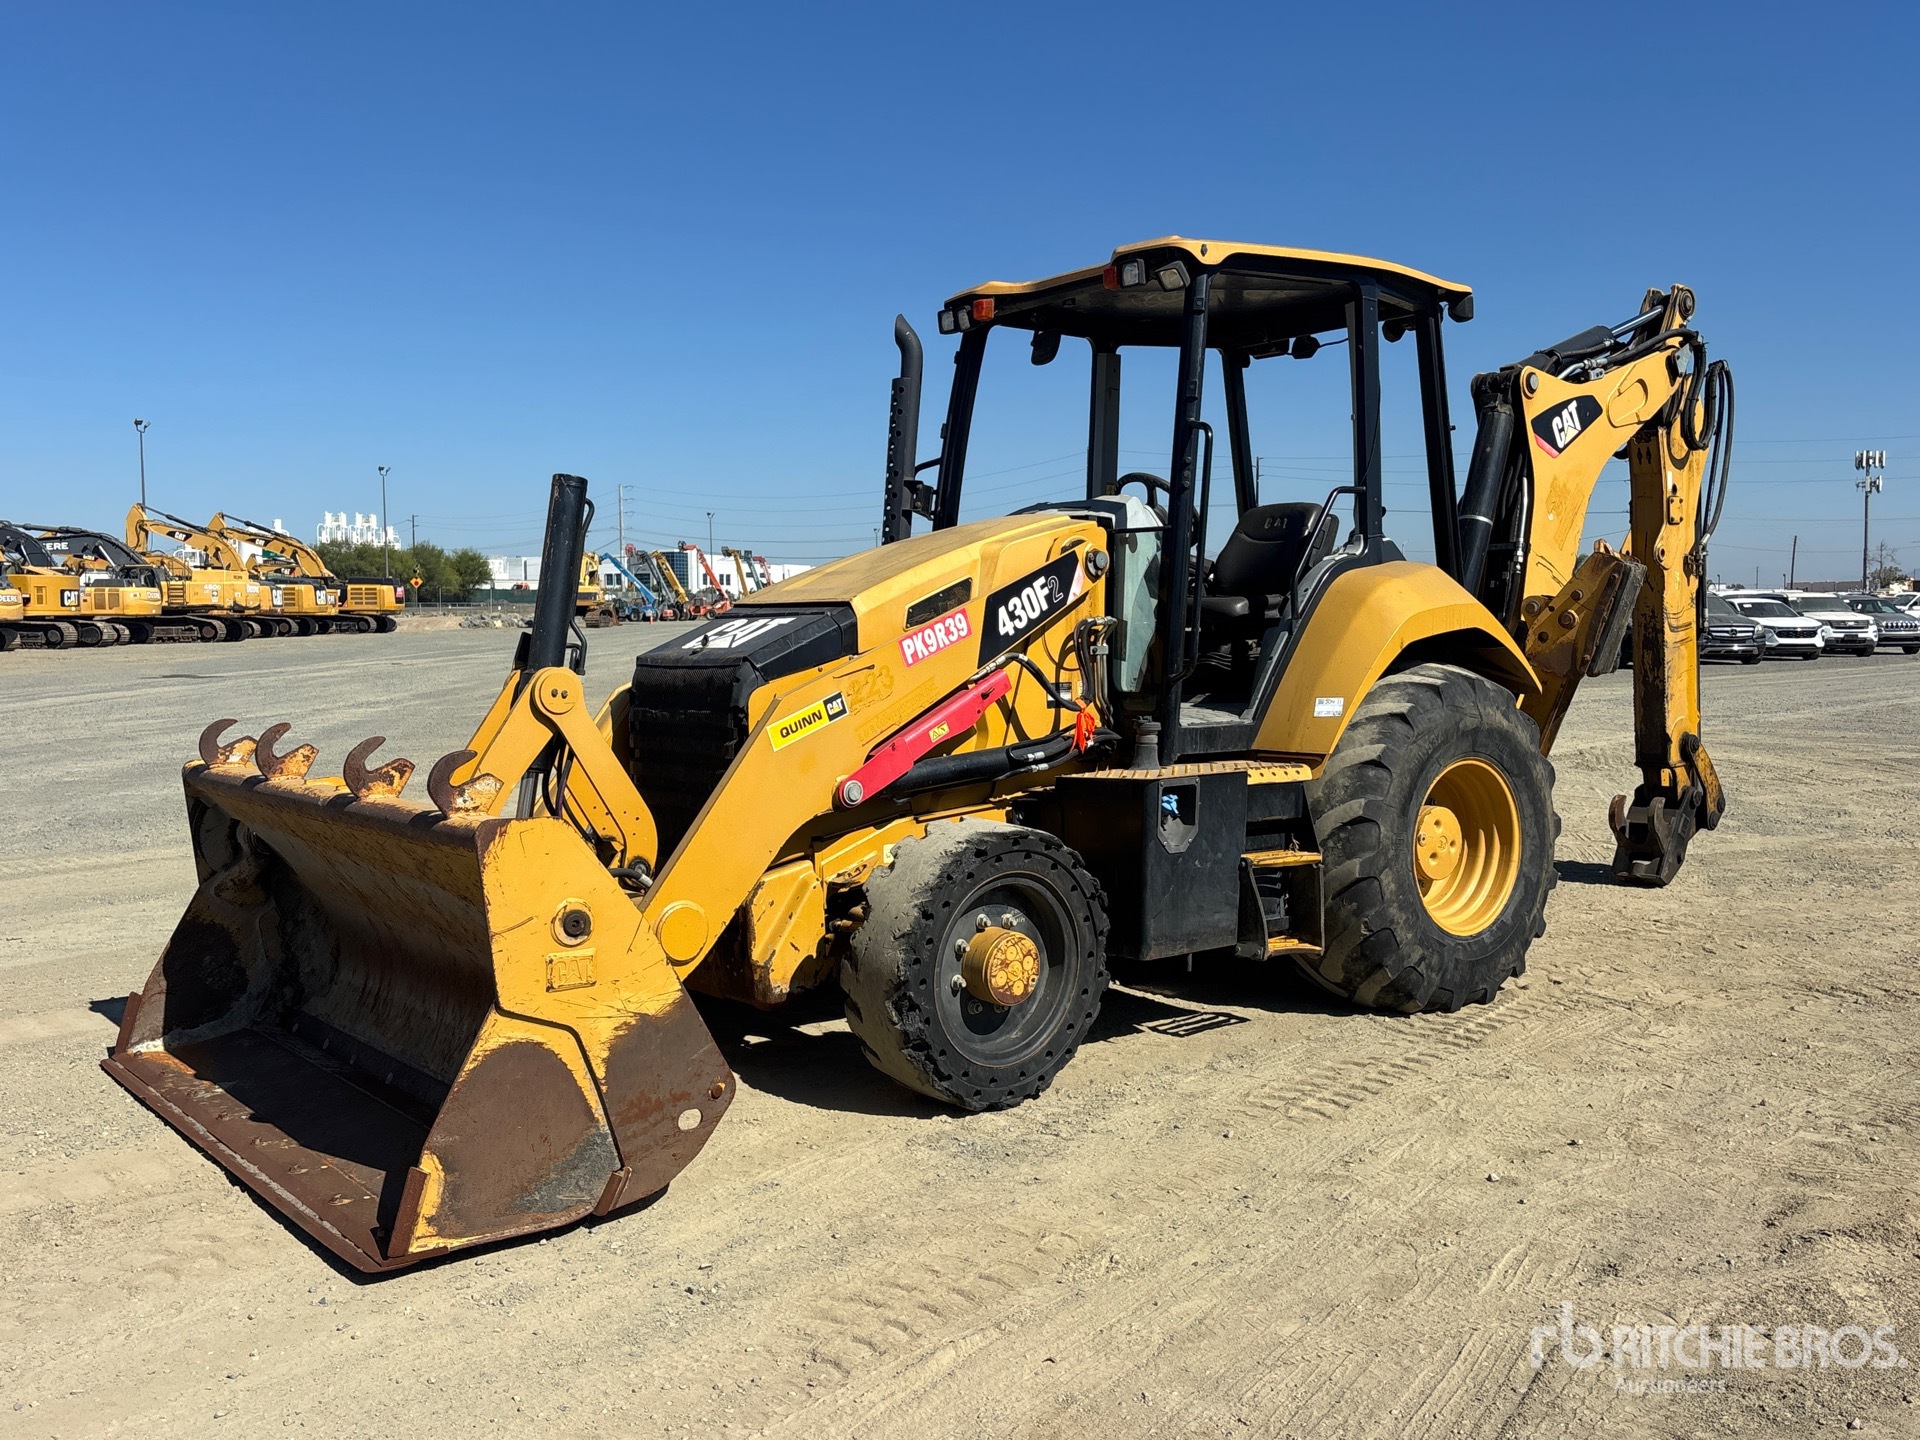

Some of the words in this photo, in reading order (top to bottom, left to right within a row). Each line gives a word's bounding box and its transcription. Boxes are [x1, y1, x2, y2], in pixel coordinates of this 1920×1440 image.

[1551, 400, 1581, 449] CAT
[43, 542, 69, 550] ERE
[174, 531, 186, 541] CAT
[255, 538, 265, 547] CAT
[63, 590, 79, 606] CAT
[998, 575, 1064, 637] 430F2
[682, 618, 797, 648] CAT
[901, 612, 968, 665] PK9R39
[779, 709, 823, 739] QUINN
[826, 697, 843, 716] CAT
[552, 957, 590, 985] CAT
